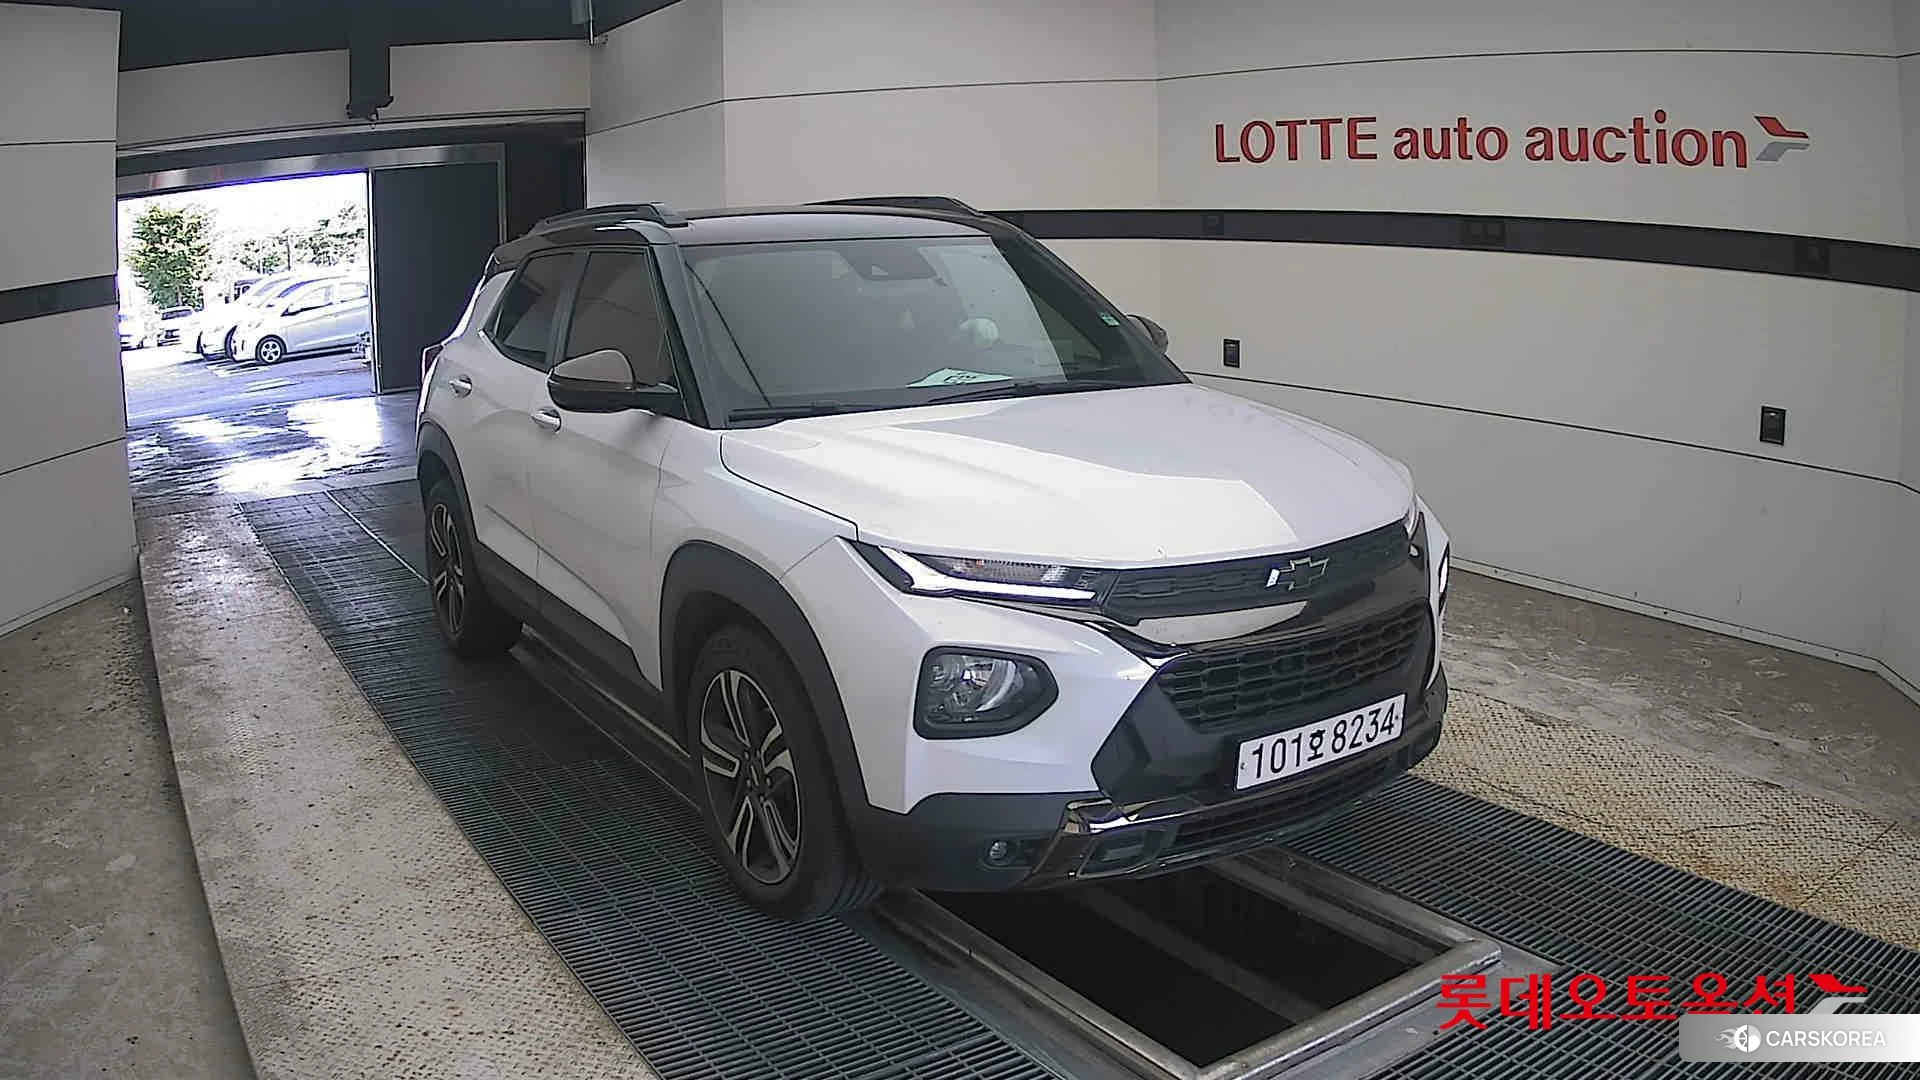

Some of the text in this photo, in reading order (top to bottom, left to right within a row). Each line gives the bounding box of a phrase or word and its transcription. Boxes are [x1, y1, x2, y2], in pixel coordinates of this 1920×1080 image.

[1215, 109, 1748, 168] LOTTE auto auction
[1252, 702, 1396, 779] 101호8234
